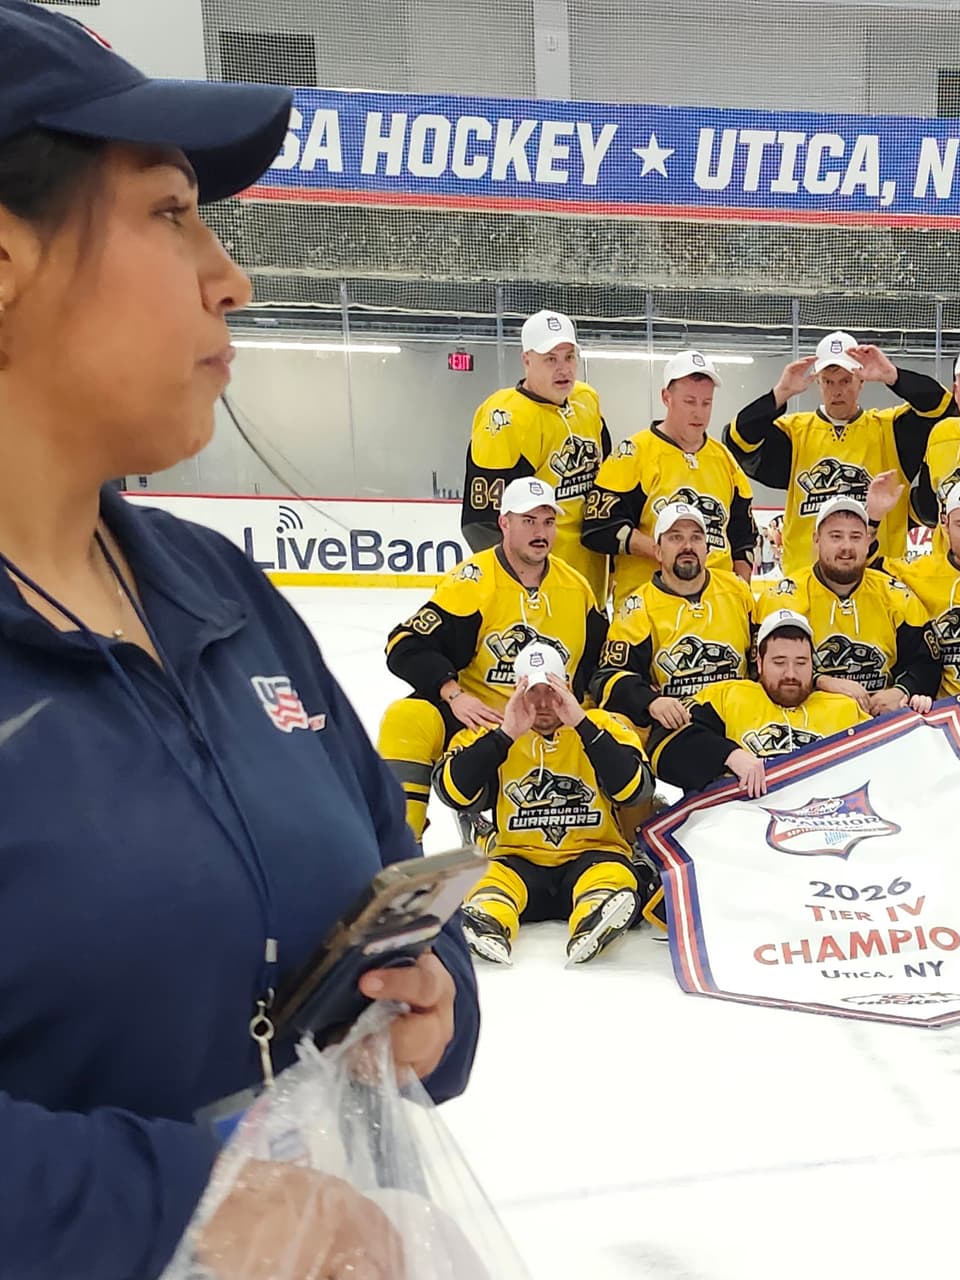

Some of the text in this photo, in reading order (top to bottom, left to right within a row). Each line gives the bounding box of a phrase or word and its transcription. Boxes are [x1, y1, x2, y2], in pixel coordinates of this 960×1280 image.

[267, 107, 344, 173] SA
[361, 111, 618, 186] HOCKEY
[692, 126, 896, 207] UTICA,
[471, 476, 506, 510] 84
[243, 525, 463, 573] LiveBarn
[512, 813, 599, 828] WARRIORS
[520, 806, 587, 817] PITTSBURGH
[809, 876, 912, 902] 2026
[804, 895, 926, 923] TIER IV
[903, 960, 945, 978] NY
